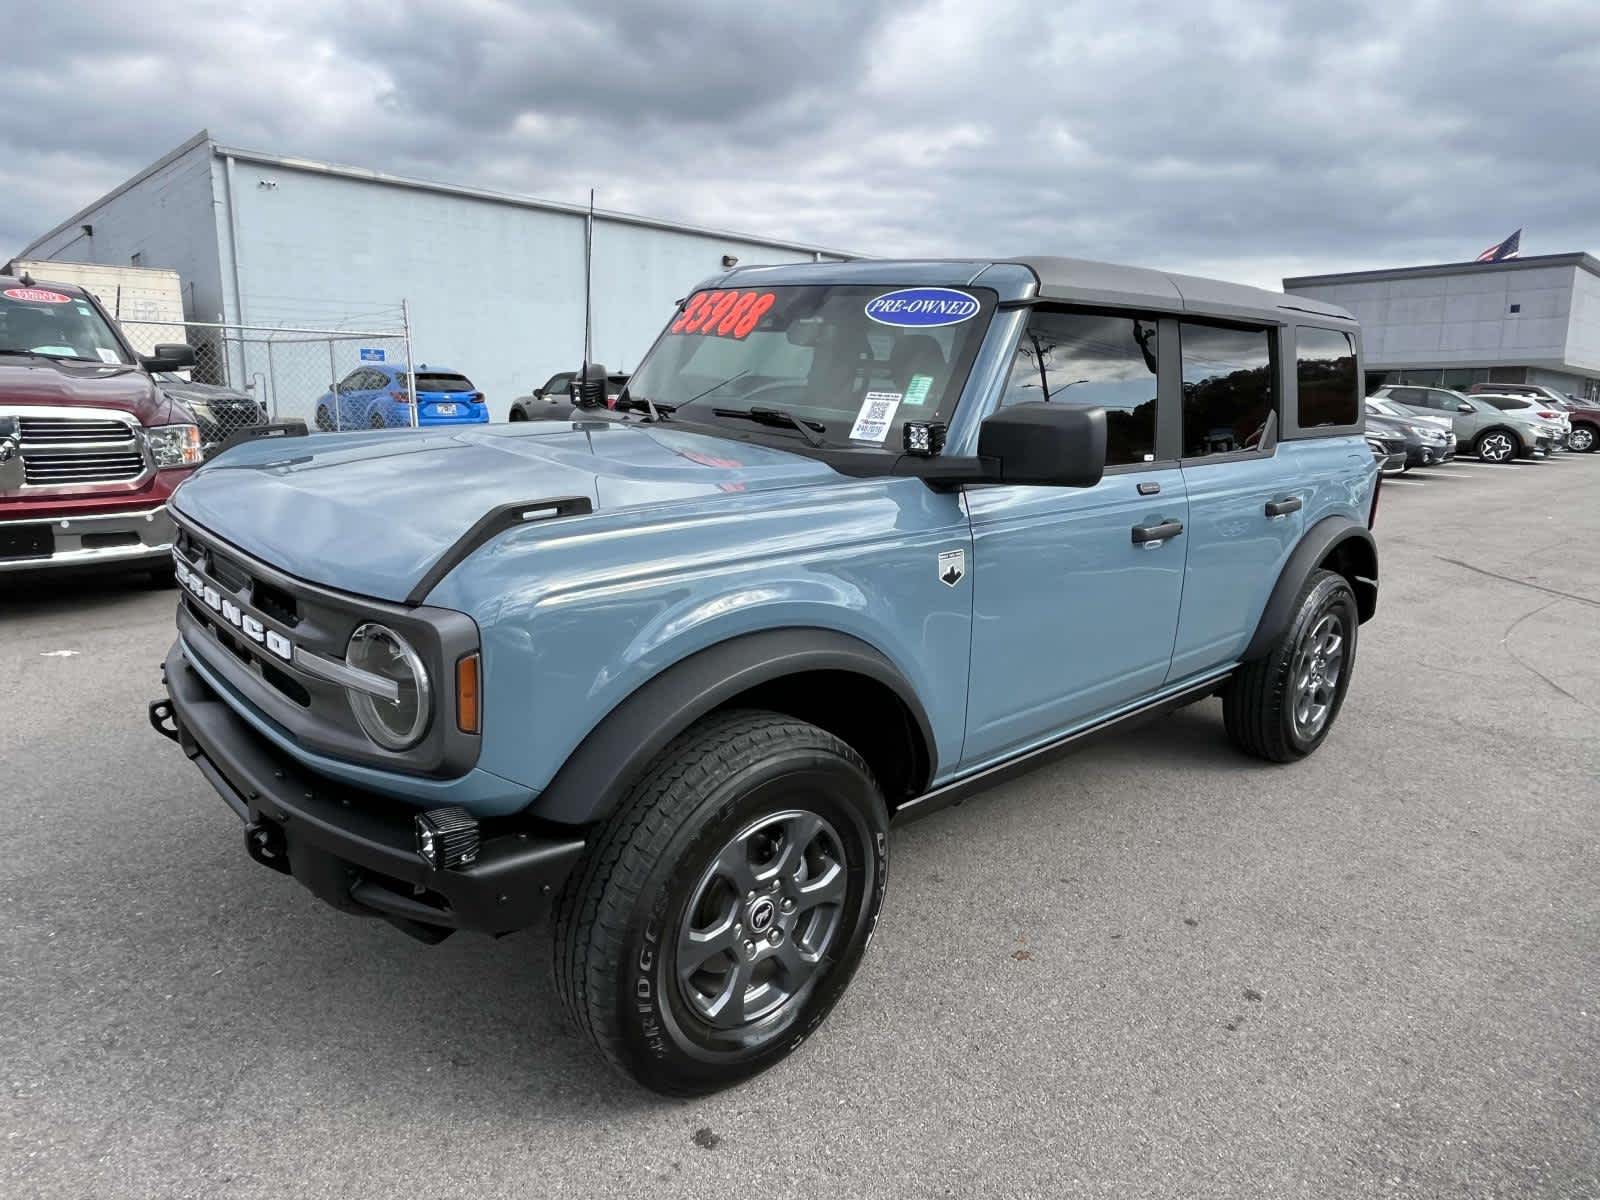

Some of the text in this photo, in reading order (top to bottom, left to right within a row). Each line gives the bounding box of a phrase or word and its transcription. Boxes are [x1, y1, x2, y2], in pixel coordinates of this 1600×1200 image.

[671, 291, 775, 339] 35988
[869, 299, 976, 316] PRE-OWNED
[175, 559, 292, 660] BRONCO
